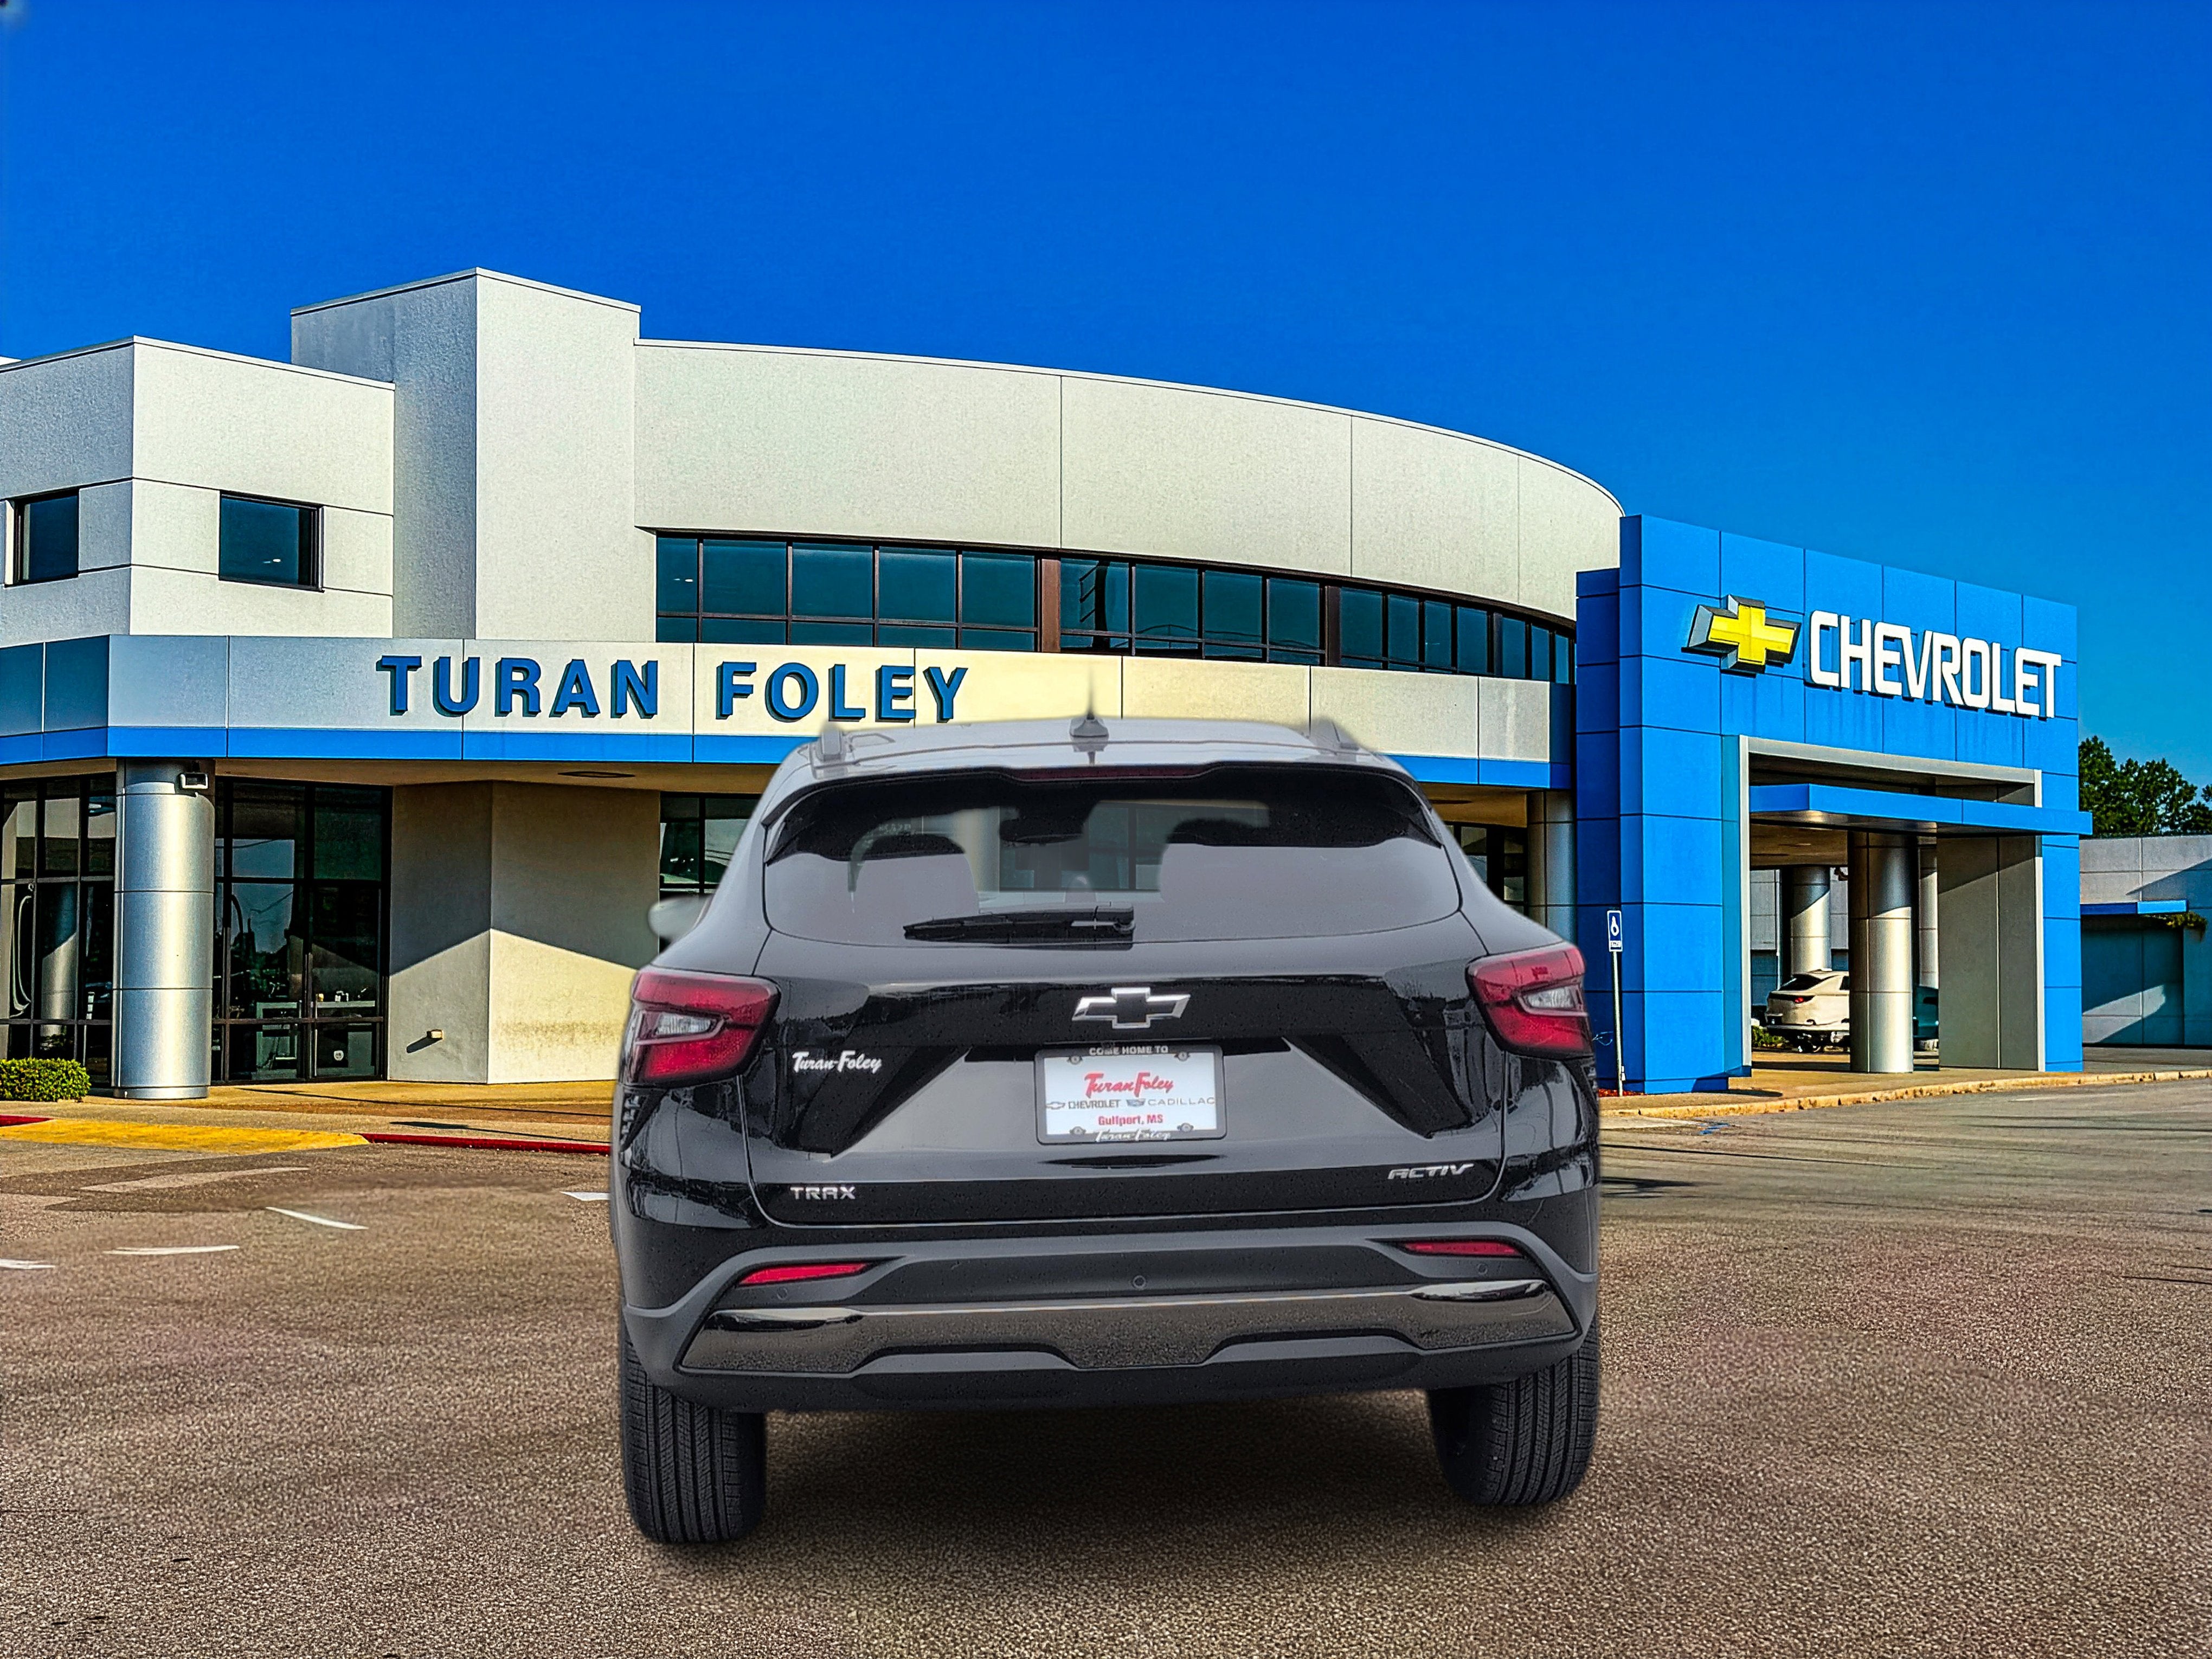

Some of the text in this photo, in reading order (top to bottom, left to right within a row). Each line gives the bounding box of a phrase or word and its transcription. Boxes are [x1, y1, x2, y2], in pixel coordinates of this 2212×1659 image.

[1809, 610, 2062, 718] CHEVROLET
[376, 655, 968, 723] TURAN FOLEY
[1122, 1046, 1153, 1055] HOME
[1154, 1045, 1169, 1053] TO
[1068, 1097, 1215, 1109] CHEVROLET CADILLAC
[1098, 1114, 1164, 1127] Gulfport, MS
[1387, 1163, 1474, 1179] ACTIV
[790, 1186, 856, 1200] TRAX
